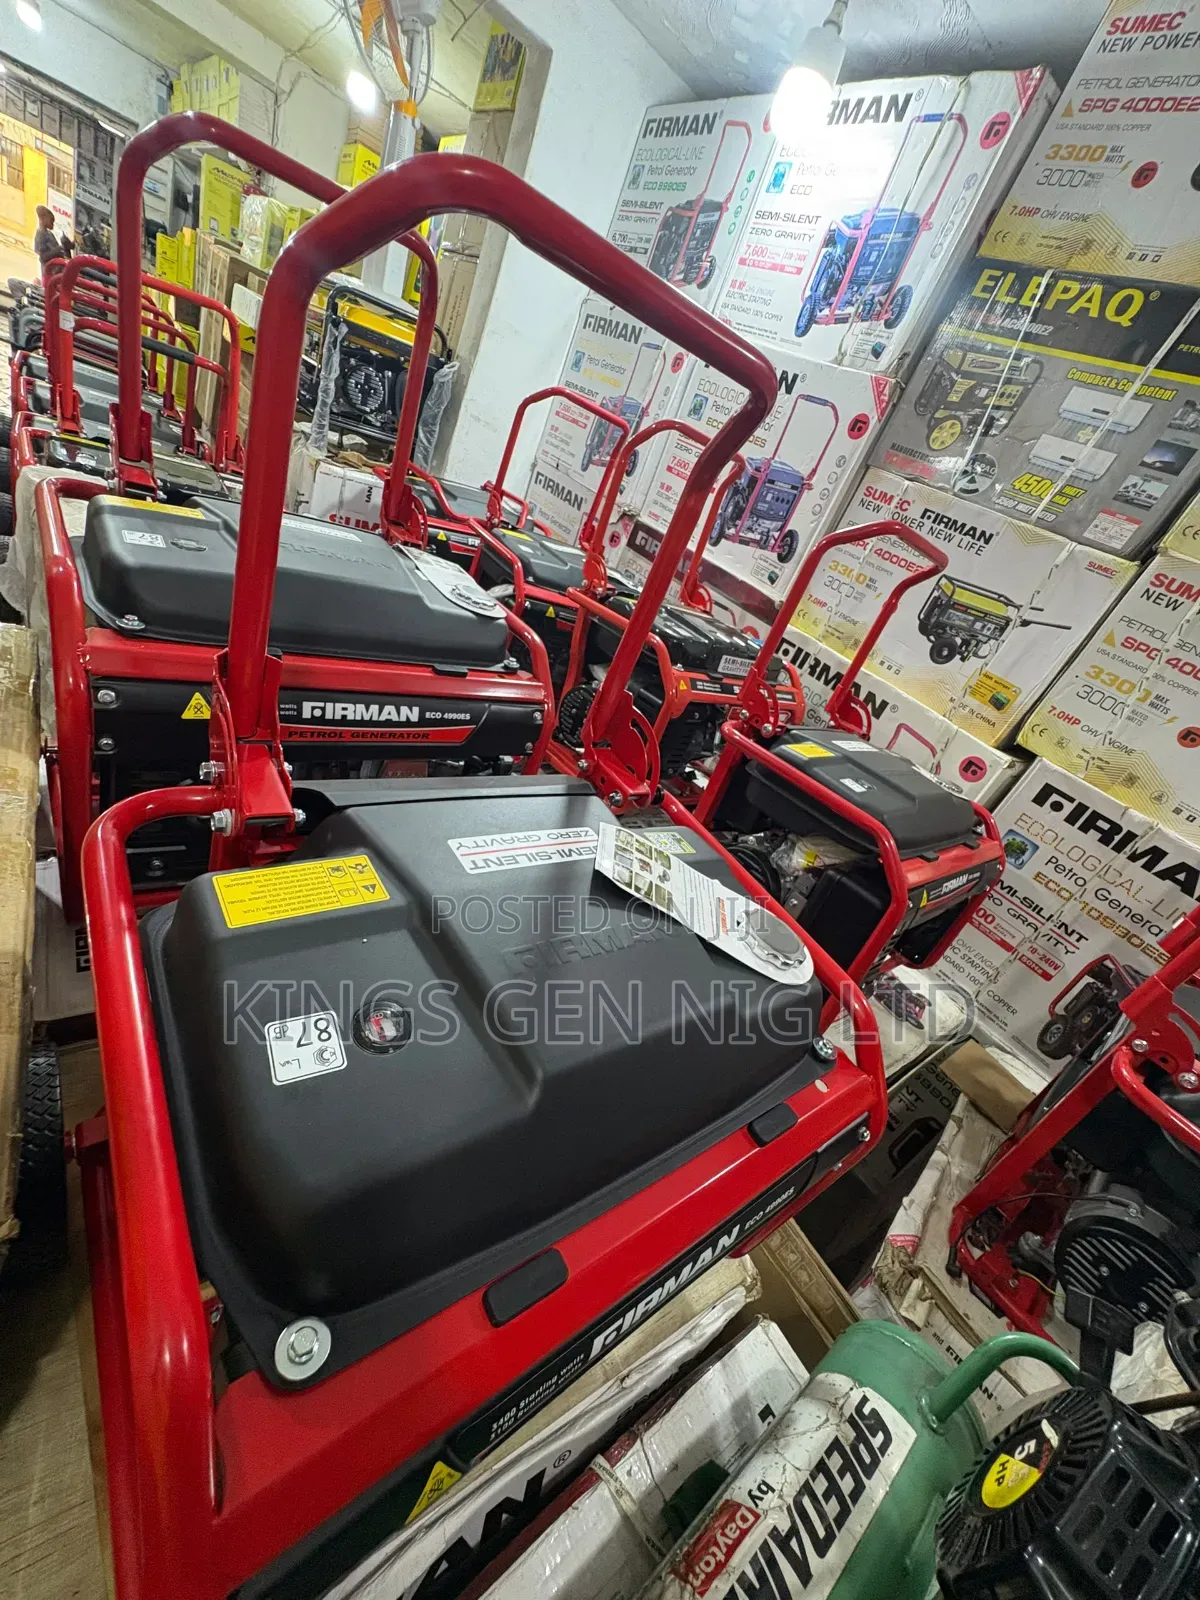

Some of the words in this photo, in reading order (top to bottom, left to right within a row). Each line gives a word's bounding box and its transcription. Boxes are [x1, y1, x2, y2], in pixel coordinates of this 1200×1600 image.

[1106, 11, 1187, 36] SUMEC
[1097, 36, 1139, 54] NEW
[1076, 77, 1124, 90] PETROL
[1078, 98, 1118, 113] SPG
[642, 112, 718, 138] FIRMAN
[1044, 144, 1108, 162] 3300
[1110, 145, 1125, 153] MAX
[1036, 168, 1087, 187] 3000
[754, 210, 822, 225] SEMI-SILENT
[1009, 205, 1041, 217] 7.0HP
[749, 227, 773, 237] ZERO
[774, 229, 815, 243] GRAVITY
[745, 244, 768, 258] 7,600
[972, 268, 1146, 328] ELEPAQ
[582, 313, 643, 344] FIRMAN
[1066, 367, 1112, 387] Compact
[1117, 378, 1178, 401] Copetent
[674, 442, 692, 455] ZERO
[671, 455, 689, 470] 7,600
[534, 471, 584, 512] FIRMAN
[1061, 484, 1087, 498] WATT
[858, 499, 883, 515] NEW
[890, 507, 925, 532] OWER
[926, 523, 950, 542] NEW
[957, 536, 986, 556] LIFE
[920, 508, 995, 545] FIRMAN
[1087, 560, 1118, 577] SUMEC
[1140, 587, 1185, 612] NEW
[1118, 615, 1168, 645] PETROL
[1096, 646, 1110, 656] USA
[1110, 650, 1149, 674] STANDARD
[1167, 678, 1200, 697] COPPER
[1147, 700, 1171, 716] WATTS
[1153, 693, 1171, 705] MAX
[302, 701, 419, 722] FIRMAN
[425, 711, 442, 720] ECO
[443, 711, 471, 721] 4990ES
[975, 711, 997, 729] CHINA
[1131, 708, 1149, 721] RATED
[287, 729, 347, 741] PETROL
[351, 730, 431, 741] GENERATOR
[1047, 706, 1081, 727] 7.0HP
[1080, 723, 1104, 740] OHV
[1107, 735, 1137, 756] NGINE
[456, 830, 544, 850] GRAVITY
[547, 828, 594, 841] ZERO
[1030, 782, 1200, 905] FIRMA
[1045, 855, 1087, 896] Petro
[1032, 871, 1074, 903] ECO
[956, 938, 975, 957] OHV
[986, 989, 1018, 1016] COPPER
[273, 1025, 289, 1040] dB
[296, 1016, 332, 1049] 87
[588, 1223, 741, 1361] FIRMAN
[743, 1212, 764, 1231] ECO
[932, 1331, 945, 1346] and
[519, 1374, 558, 1409] Starting
[560, 1353, 585, 1376] watts
[1013, 1437, 1038, 1461] 5
[995, 1458, 1011, 1488] HP
[750, 1479, 776, 1509] by
[690, 1506, 760, 1596] Dayton
